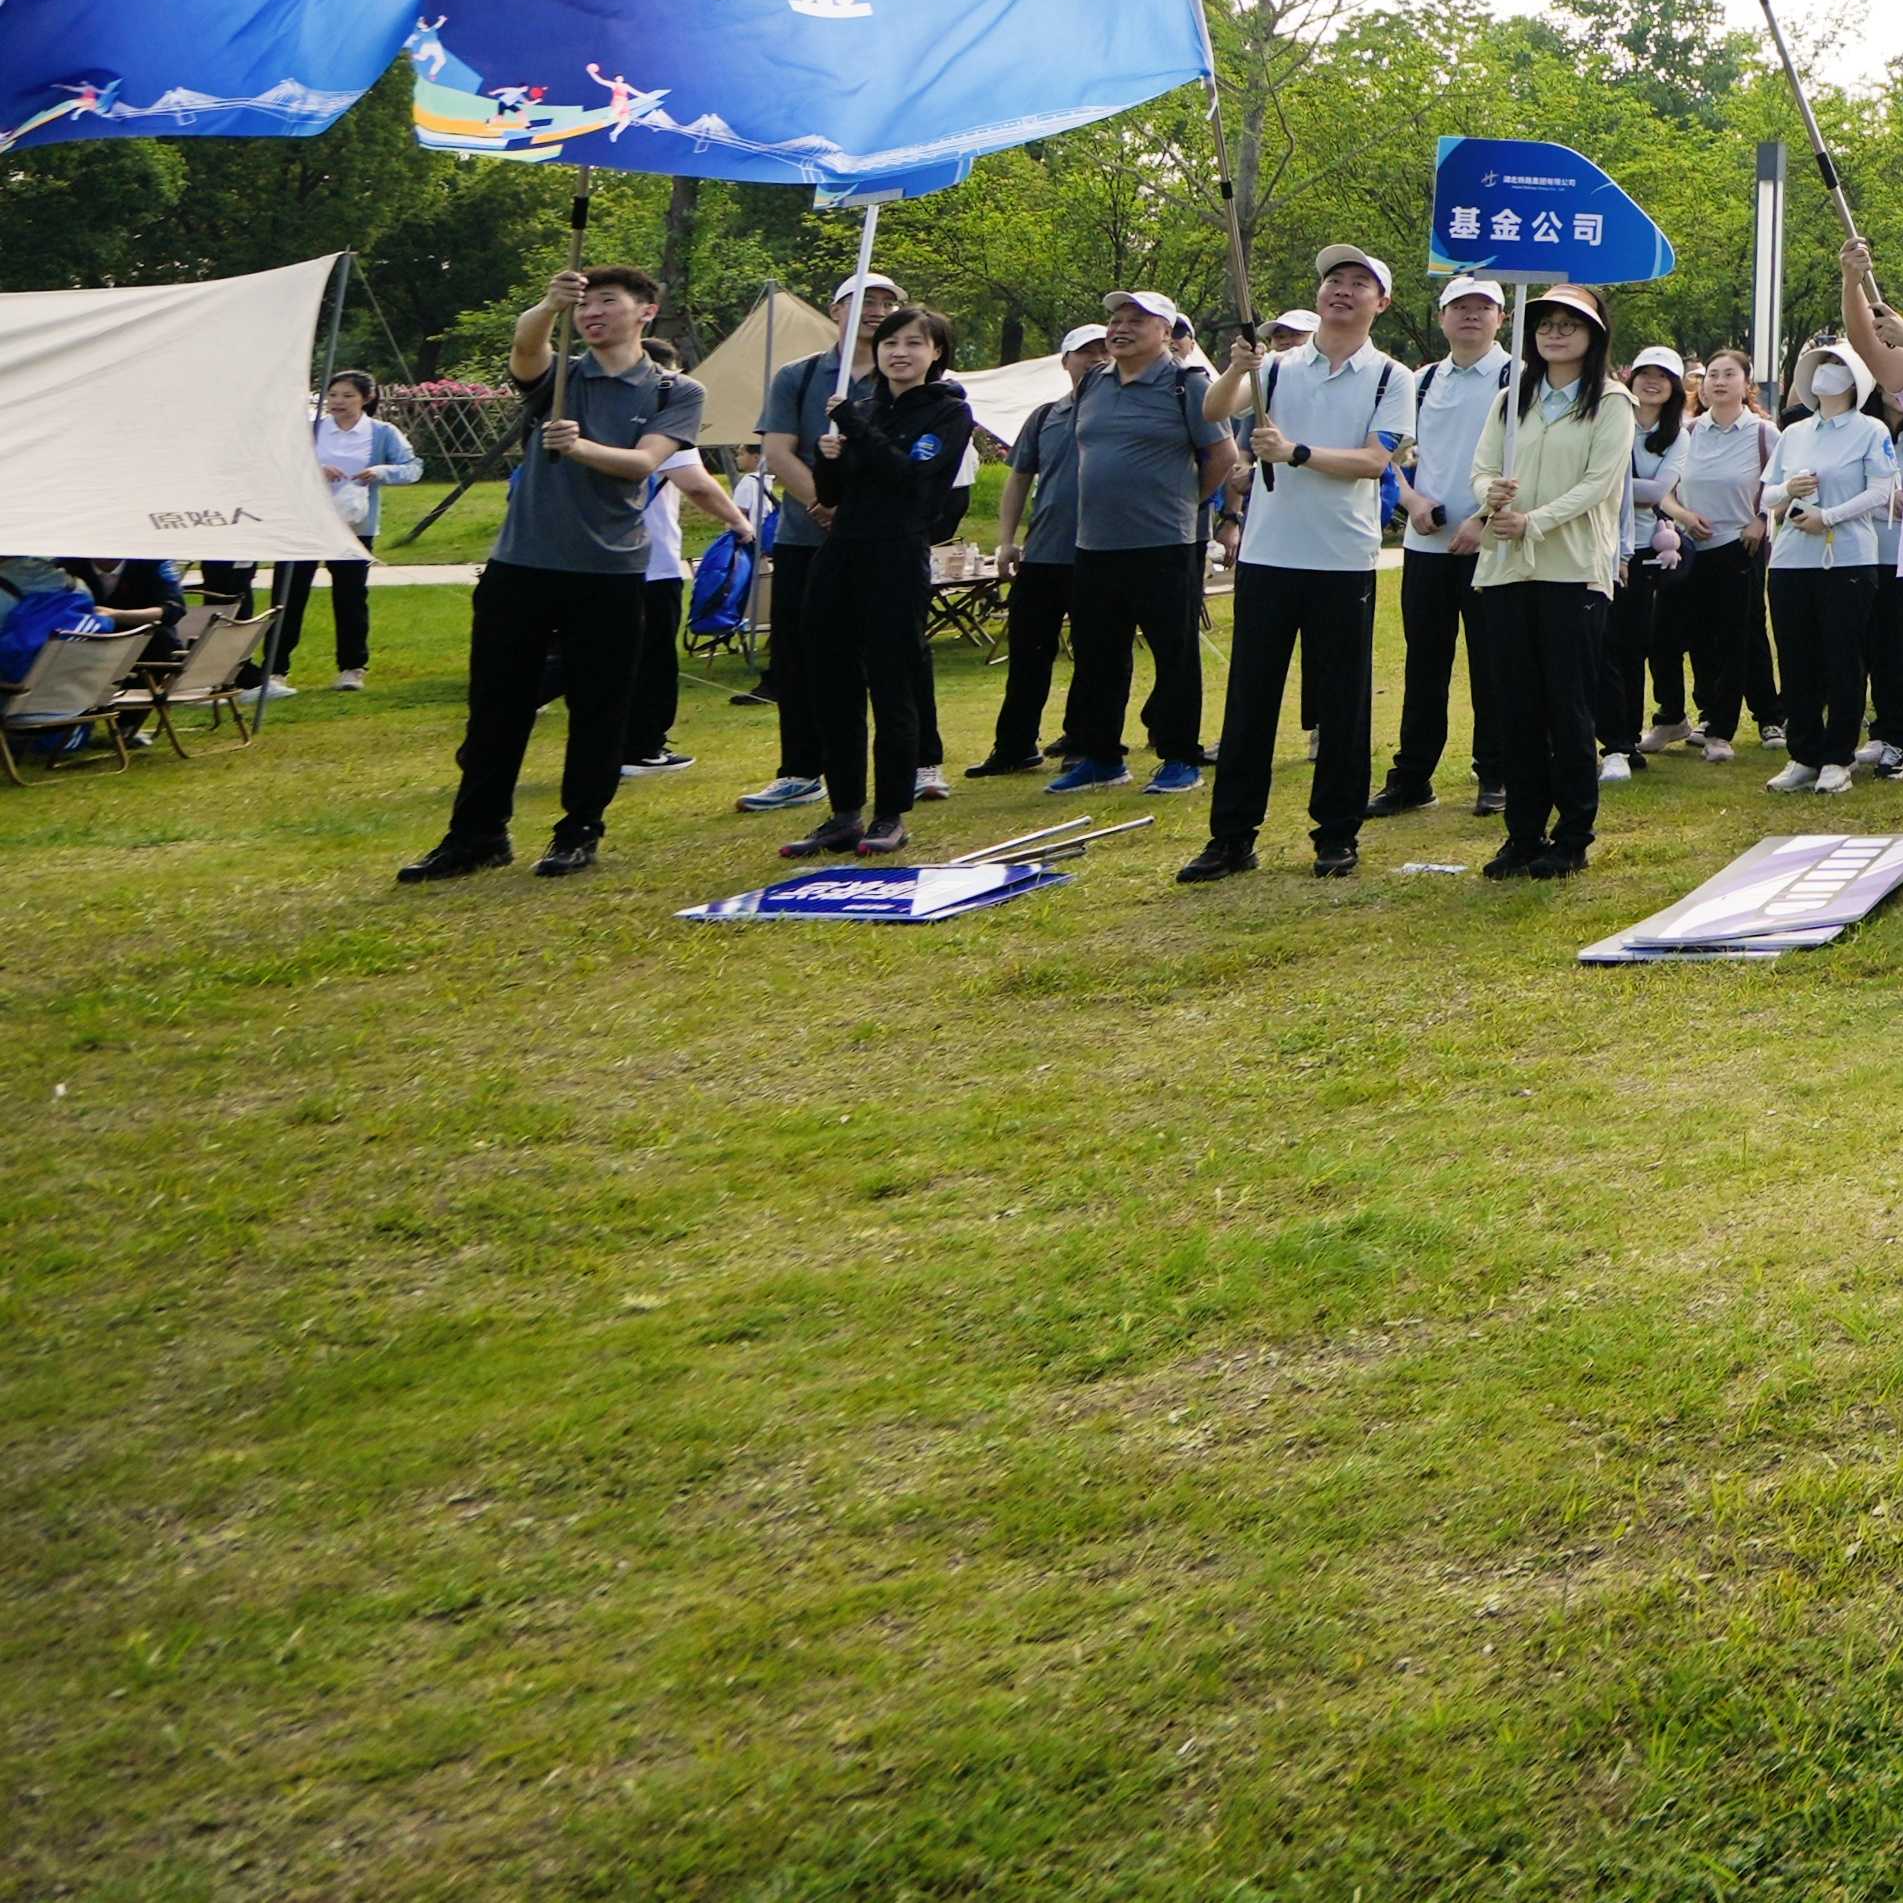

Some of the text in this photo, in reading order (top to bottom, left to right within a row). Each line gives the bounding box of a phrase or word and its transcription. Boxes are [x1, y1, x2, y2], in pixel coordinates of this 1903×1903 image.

[1448, 205, 1605, 247] 基金公司
[148, 507, 264, 530] 原始人
